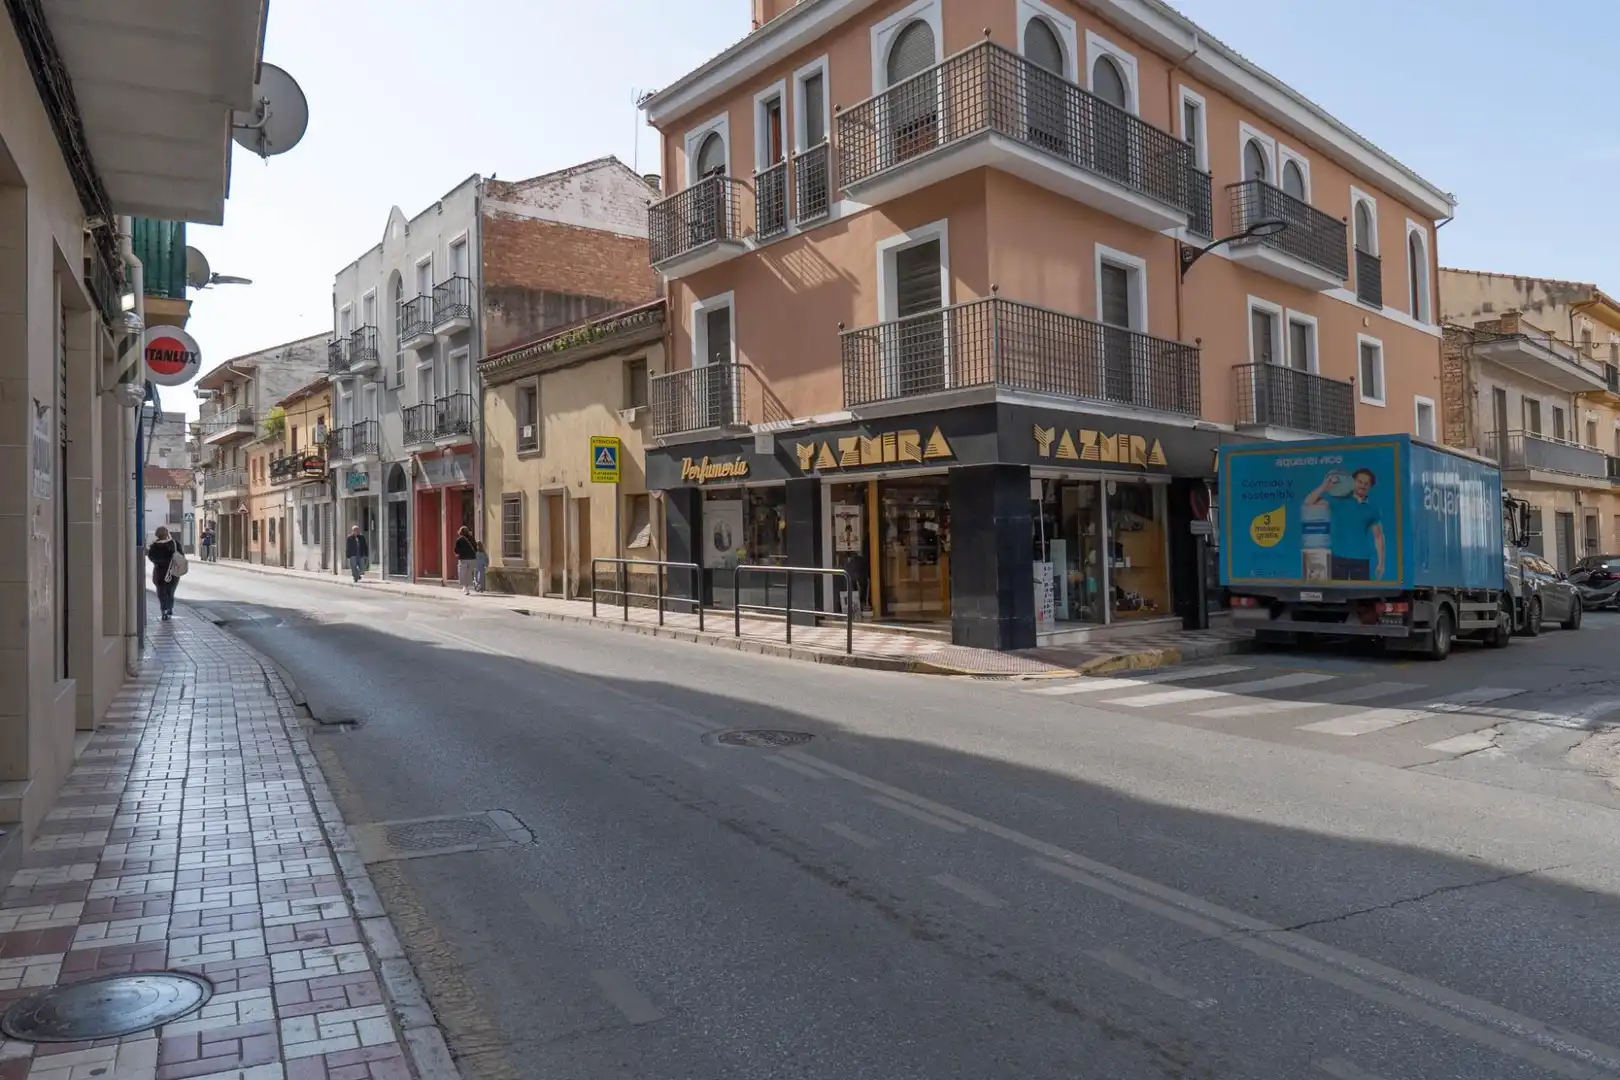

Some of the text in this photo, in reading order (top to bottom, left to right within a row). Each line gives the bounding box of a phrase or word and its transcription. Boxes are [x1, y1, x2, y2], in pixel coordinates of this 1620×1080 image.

[144, 348, 200, 365] ITANLUX
[796, 425, 953, 470] YAZMIRA
[1033, 423, 1168, 469] YAZMIRA
[681, 455, 748, 484] Perfumería
[1263, 514, 1272, 526] 3
